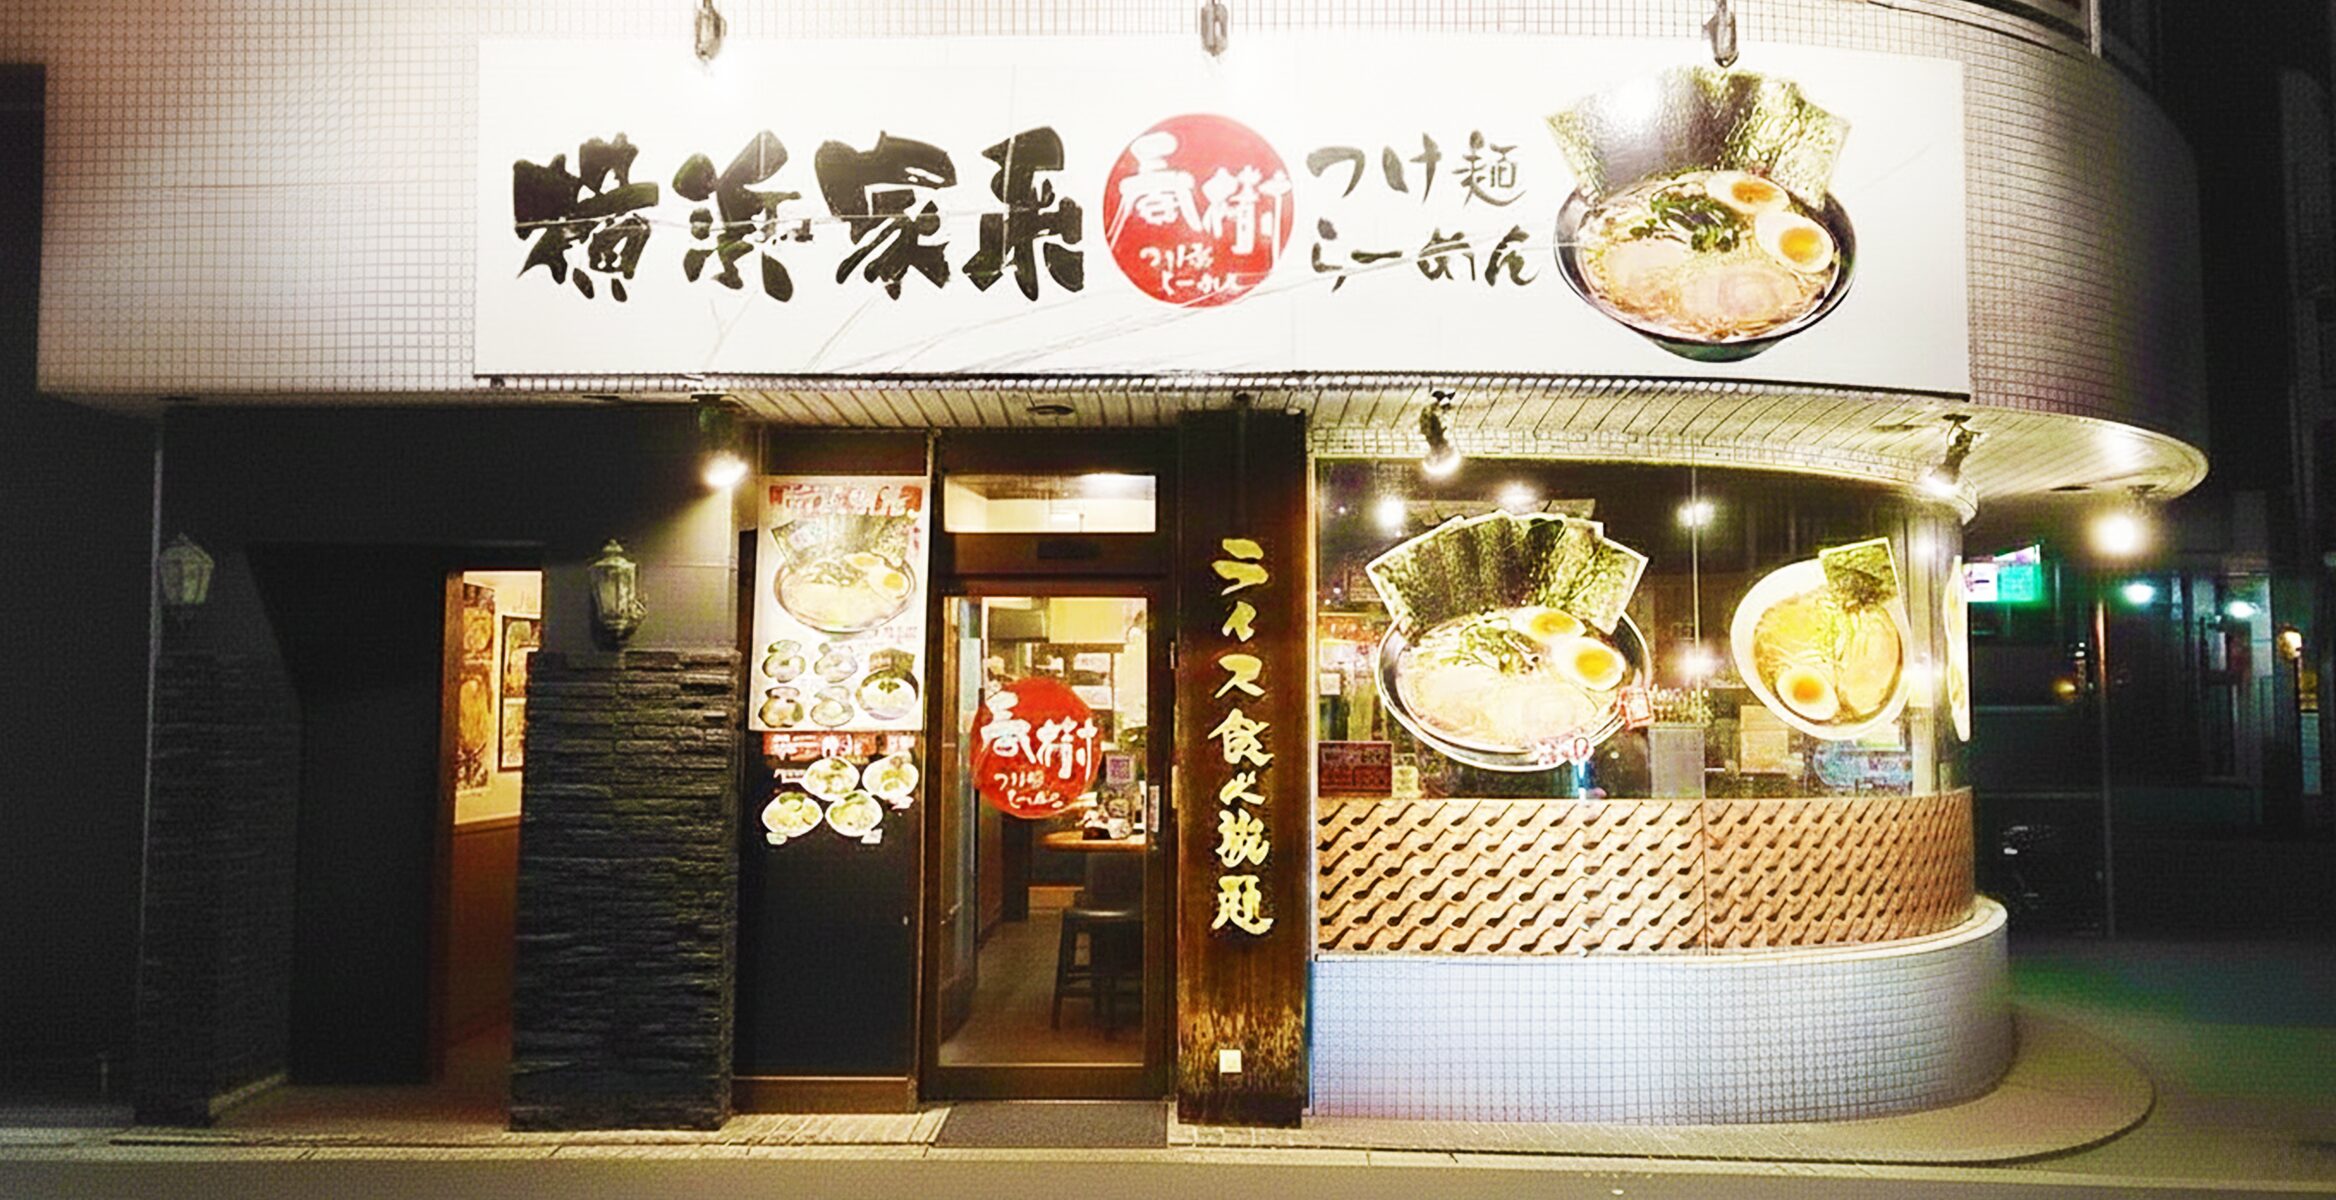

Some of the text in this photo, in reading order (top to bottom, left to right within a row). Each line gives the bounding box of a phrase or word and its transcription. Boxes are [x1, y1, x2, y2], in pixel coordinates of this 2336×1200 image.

[513, 125, 1084, 302] 横浜家系
[1306, 130, 1527, 207] つけ麺
[1311, 217, 1541, 293] らーめん
[1207, 537, 1275, 936] ライス食べ放題
